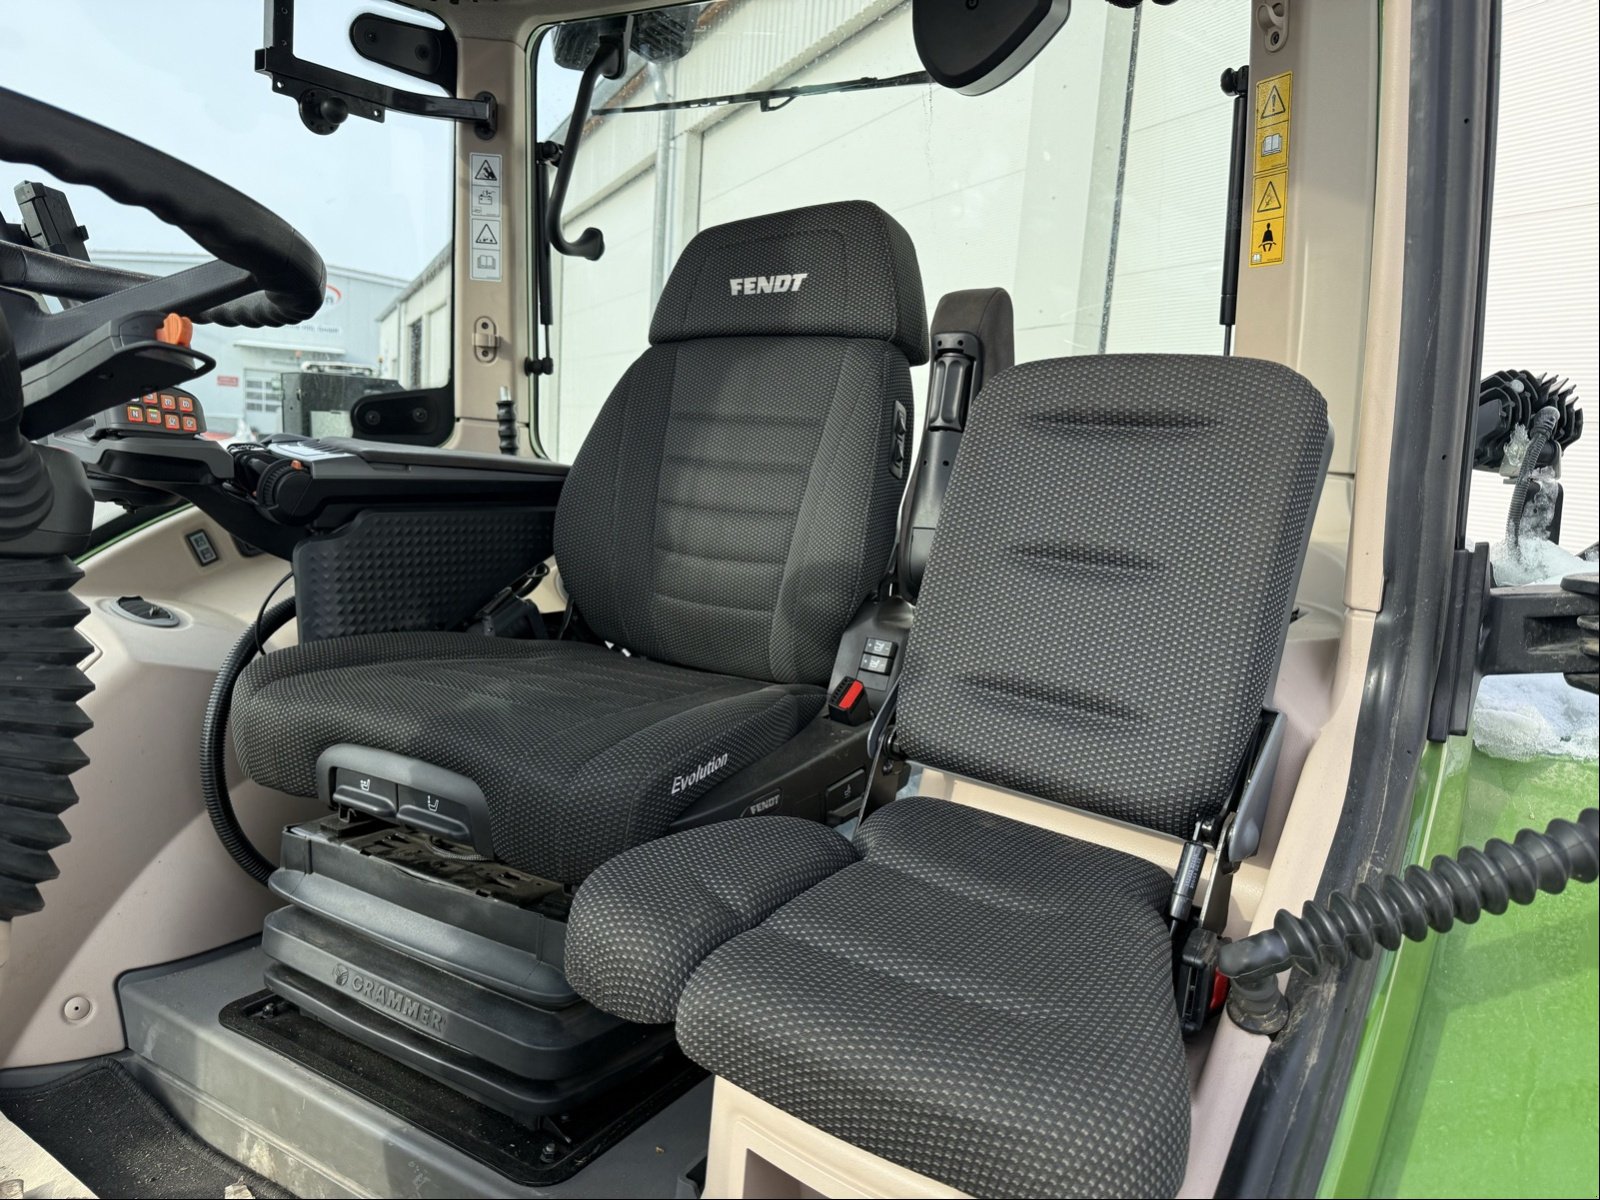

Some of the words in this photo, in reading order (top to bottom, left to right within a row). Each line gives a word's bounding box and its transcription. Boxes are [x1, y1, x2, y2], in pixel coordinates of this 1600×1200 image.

[730, 273, 808, 296] FENDT
[671, 753, 728, 794] Evolution
[750, 795, 780, 814] FENDT
[352, 975, 445, 1032] GRAMMER
